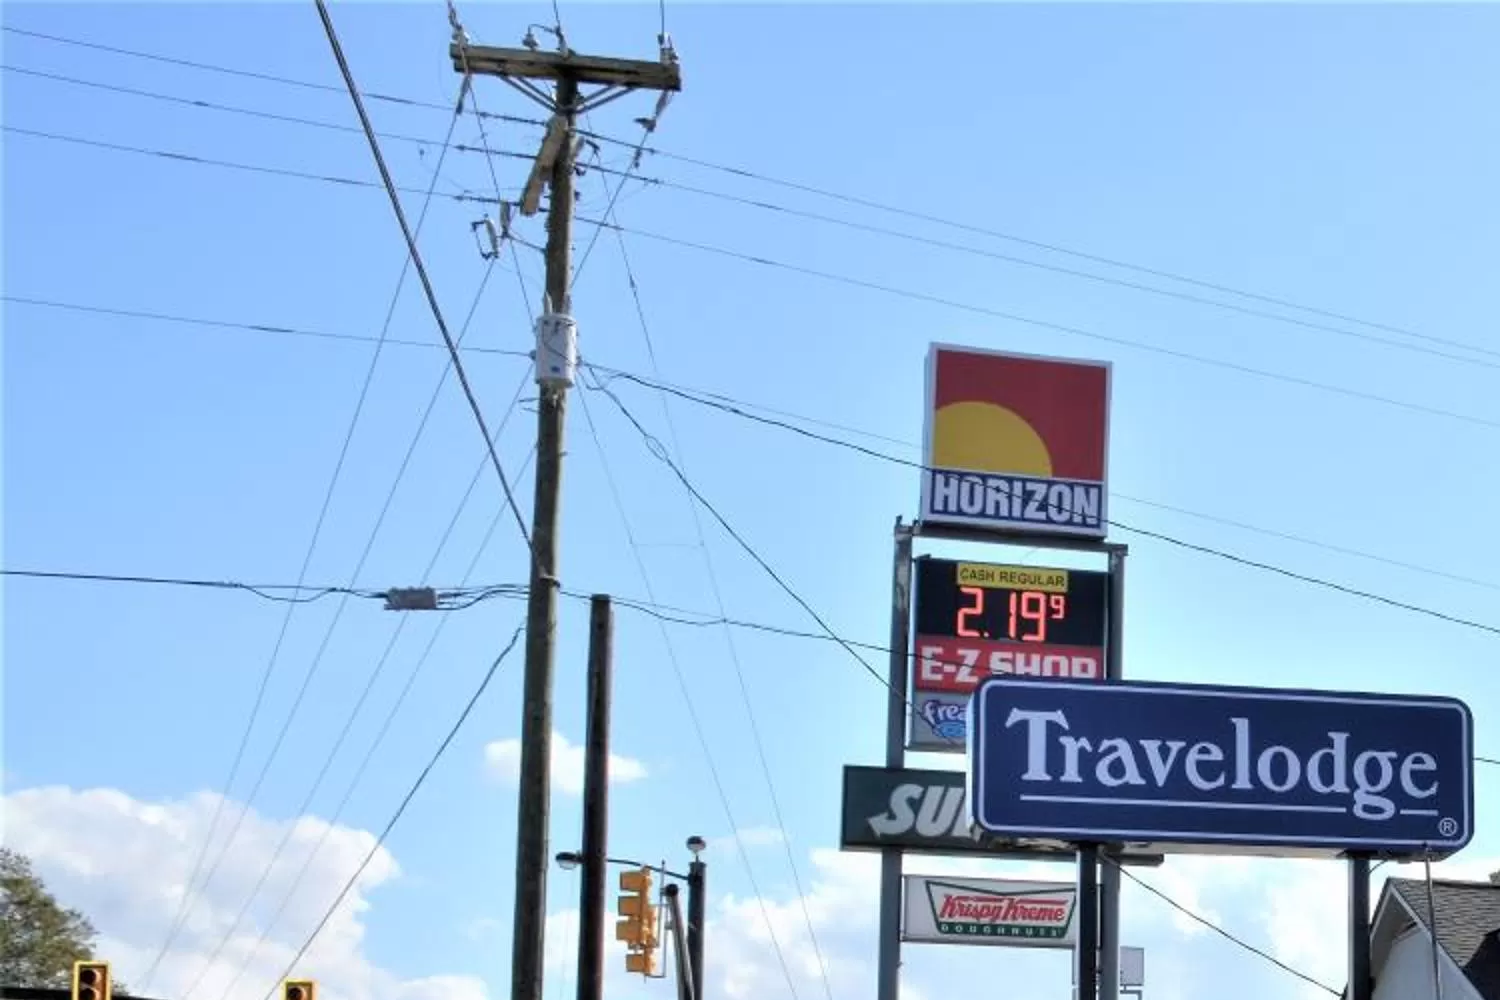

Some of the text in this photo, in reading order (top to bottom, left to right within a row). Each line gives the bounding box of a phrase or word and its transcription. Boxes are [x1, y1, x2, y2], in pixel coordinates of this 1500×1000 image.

[933, 472, 1099, 525] HORIZON
[959, 567, 1066, 587] CASH REGULAR
[920, 646, 982, 683] E-Z
[1005, 706, 1439, 820] Travelodge
[939, 893, 1069, 924] Krispy Kreme
[940, 925, 1058, 937] DOUGHNUTS
